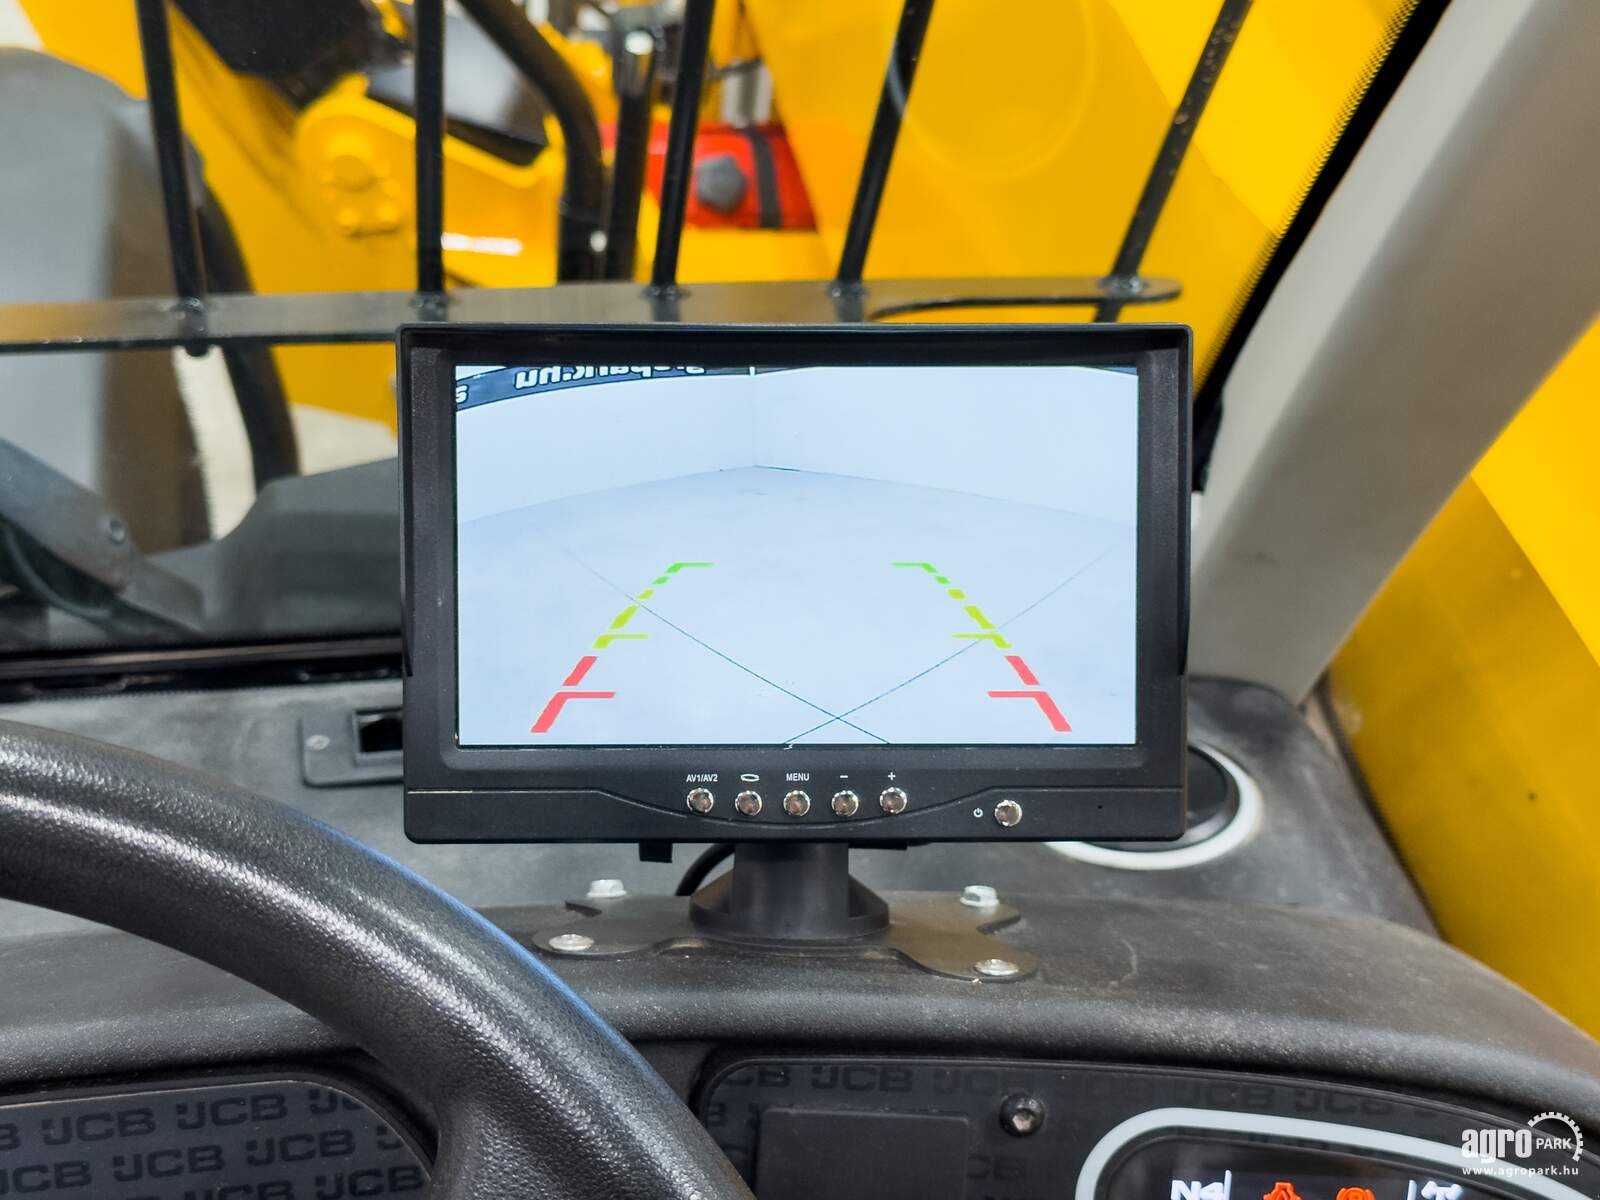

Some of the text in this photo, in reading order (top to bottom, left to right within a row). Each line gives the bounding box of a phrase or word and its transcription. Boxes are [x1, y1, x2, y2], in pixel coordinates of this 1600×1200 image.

[685, 774, 719, 783] AV1/AV2
[785, 772, 811, 782] MENU
[812, 1065, 913, 1093] JCB
[41, 1107, 156, 1146] JCB
[176, 1093, 288, 1130] JCB
[113, 1144, 226, 1182] JCB
[246, 1129, 356, 1166] JCB
